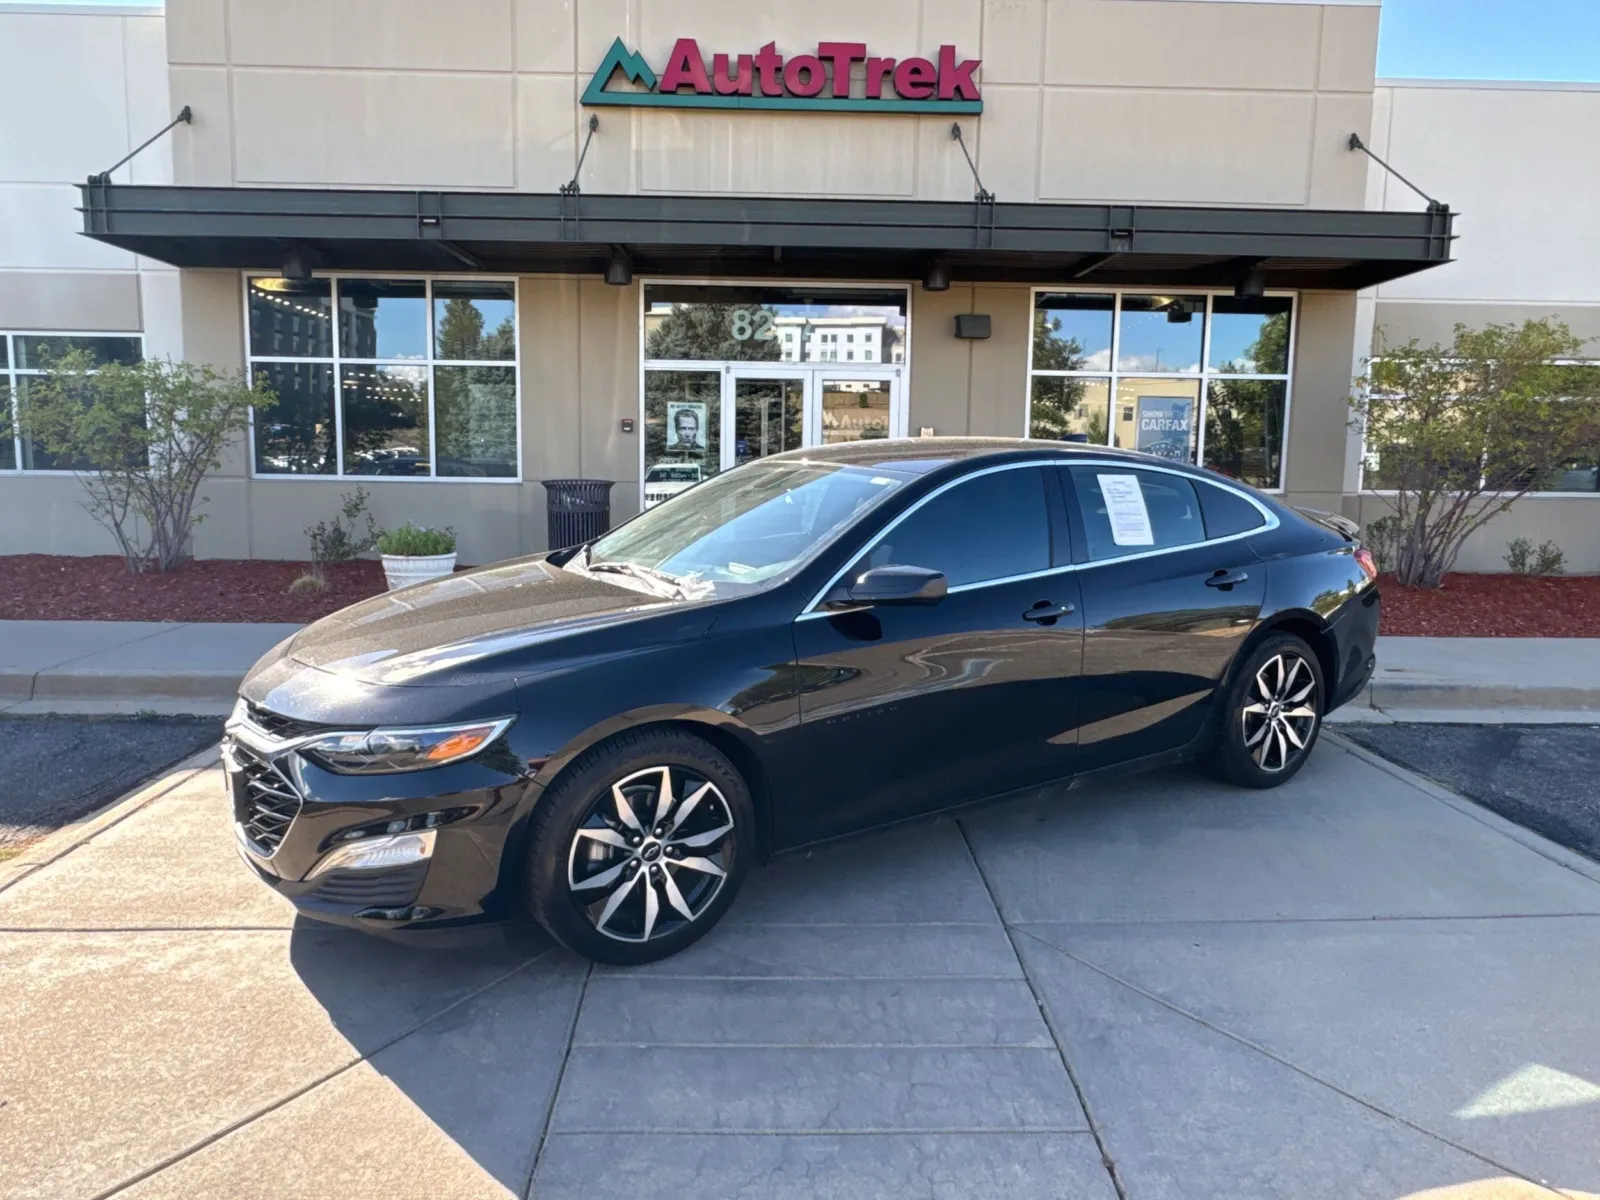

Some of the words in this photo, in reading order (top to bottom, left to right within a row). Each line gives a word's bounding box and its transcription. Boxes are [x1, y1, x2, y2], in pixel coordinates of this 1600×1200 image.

[659, 37, 983, 100] AutoTrek
[1141, 410, 1164, 418] SHOW
[1141, 418, 1189, 431] CARFAX
